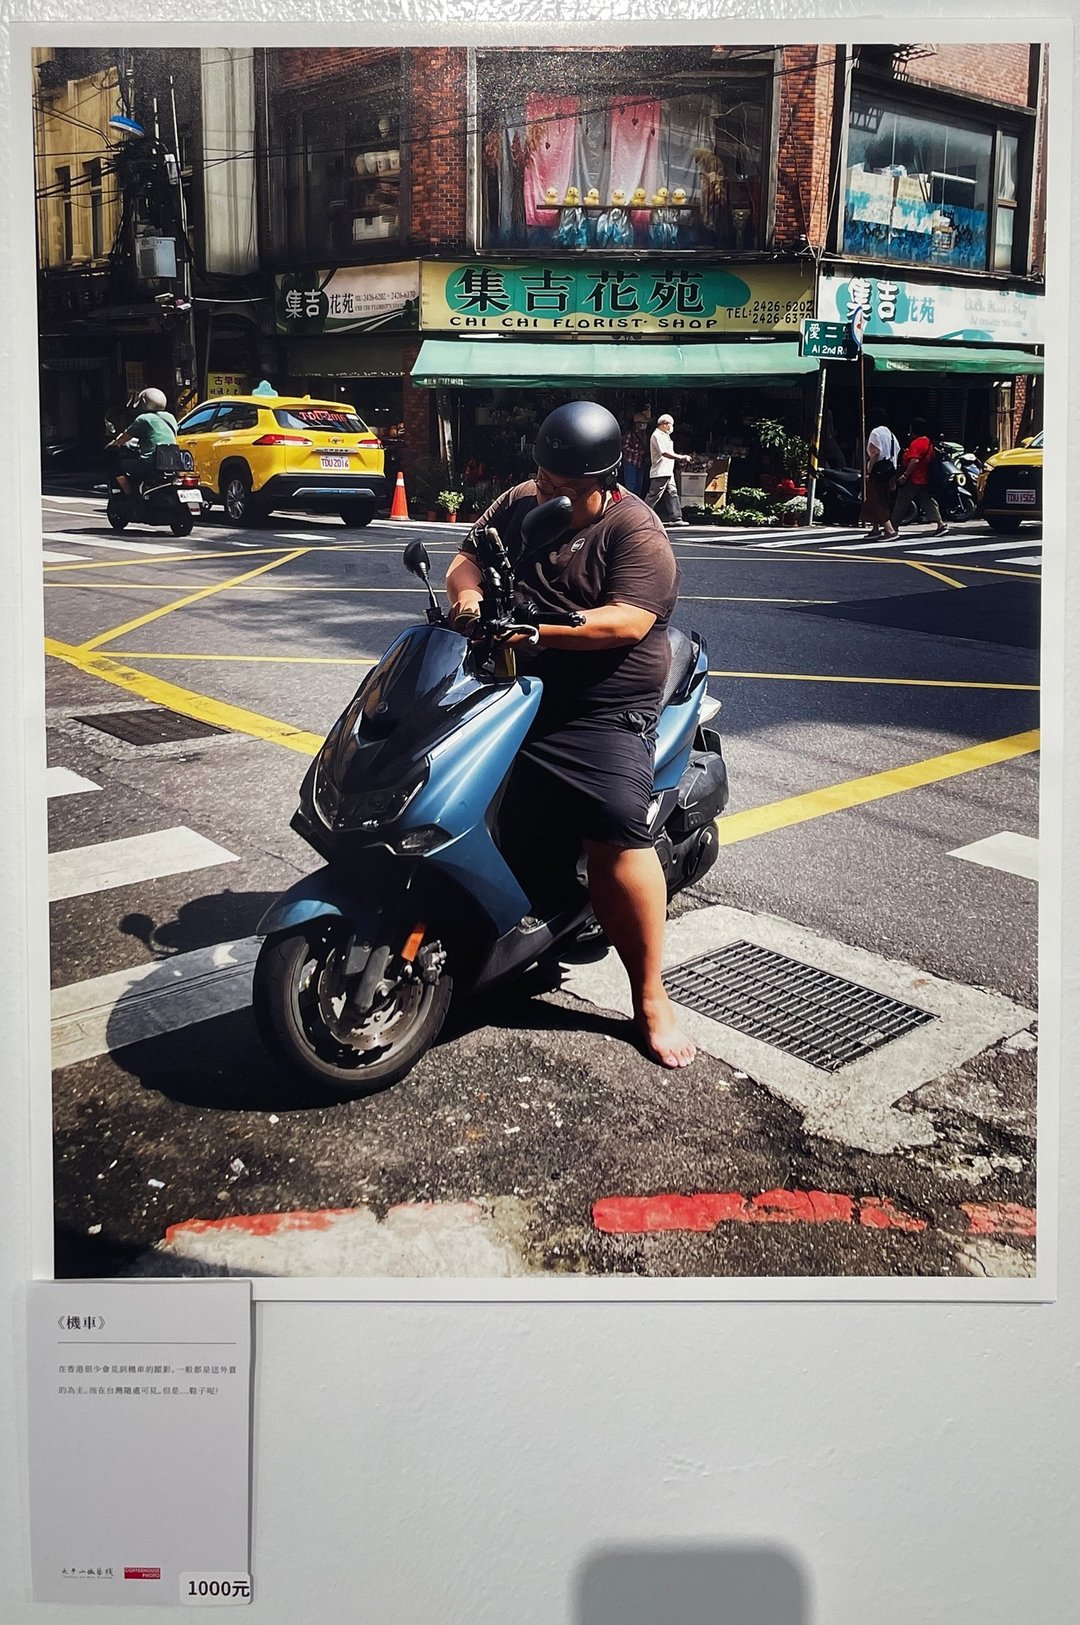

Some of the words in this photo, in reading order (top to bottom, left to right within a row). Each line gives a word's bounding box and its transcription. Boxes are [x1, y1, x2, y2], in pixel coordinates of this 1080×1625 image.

[454, 268, 705, 313] 集吉花苑
[285, 289, 354, 318] 集吉花苑
[726, 308, 752, 319] TEL:
[753, 301, 812, 312] 2426-6202
[449, 317, 486, 327] CHI
[502, 318, 538, 327] CHI
[658, 318, 717, 329] SHOP
[821, 345, 836, 355] 2nd
[57, 1315, 106, 1330] 《機車》
[188, 1580, 250, 1598] 1000元
